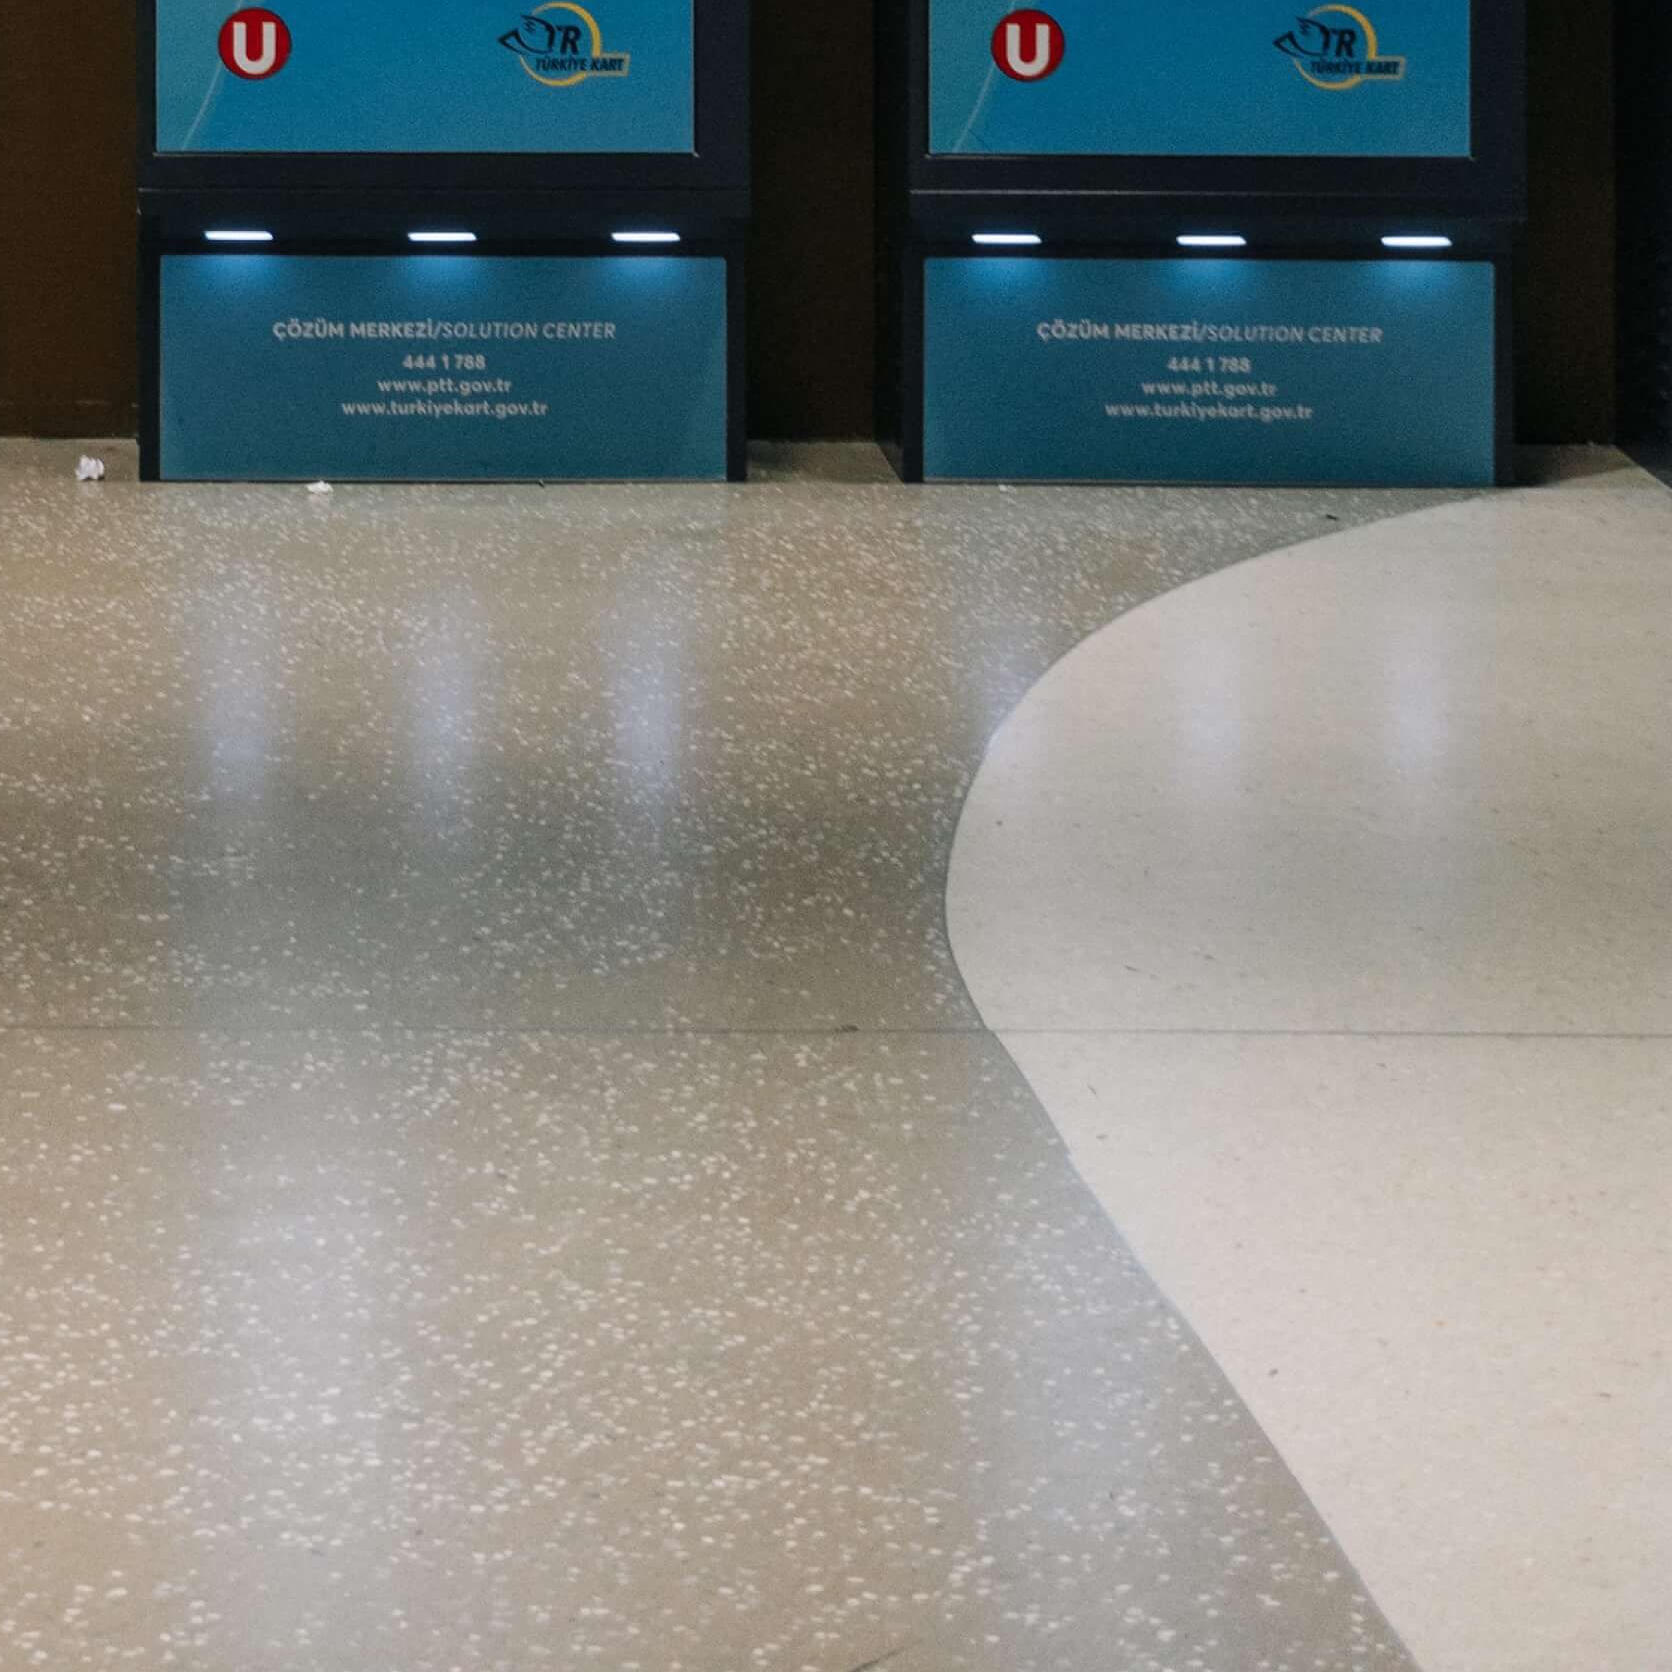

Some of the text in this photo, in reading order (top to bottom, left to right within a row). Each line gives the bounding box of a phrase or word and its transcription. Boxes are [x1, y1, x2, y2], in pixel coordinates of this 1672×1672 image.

[232, 21, 278, 75] U
[1006, 23, 1052, 77] U
[589, 57, 626, 72] KART
[272, 317, 346, 341] ÇÖZÜM
[541, 322, 616, 339] CENTER
[1036, 318, 1112, 342] ÇÖZÜM
[1306, 326, 1384, 344] CENTER
[402, 353, 486, 370] 444 1 788
[1166, 356, 1252, 373] 444 1 788
[376, 377, 512, 397] www.ptt.gov.tr
[1141, 380, 1277, 400] www.ptt.gov.tr
[341, 398, 548, 419] www.turkiyekart.gov.tr
[1104, 401, 1313, 423] www.turkiyekart.gov.tr
